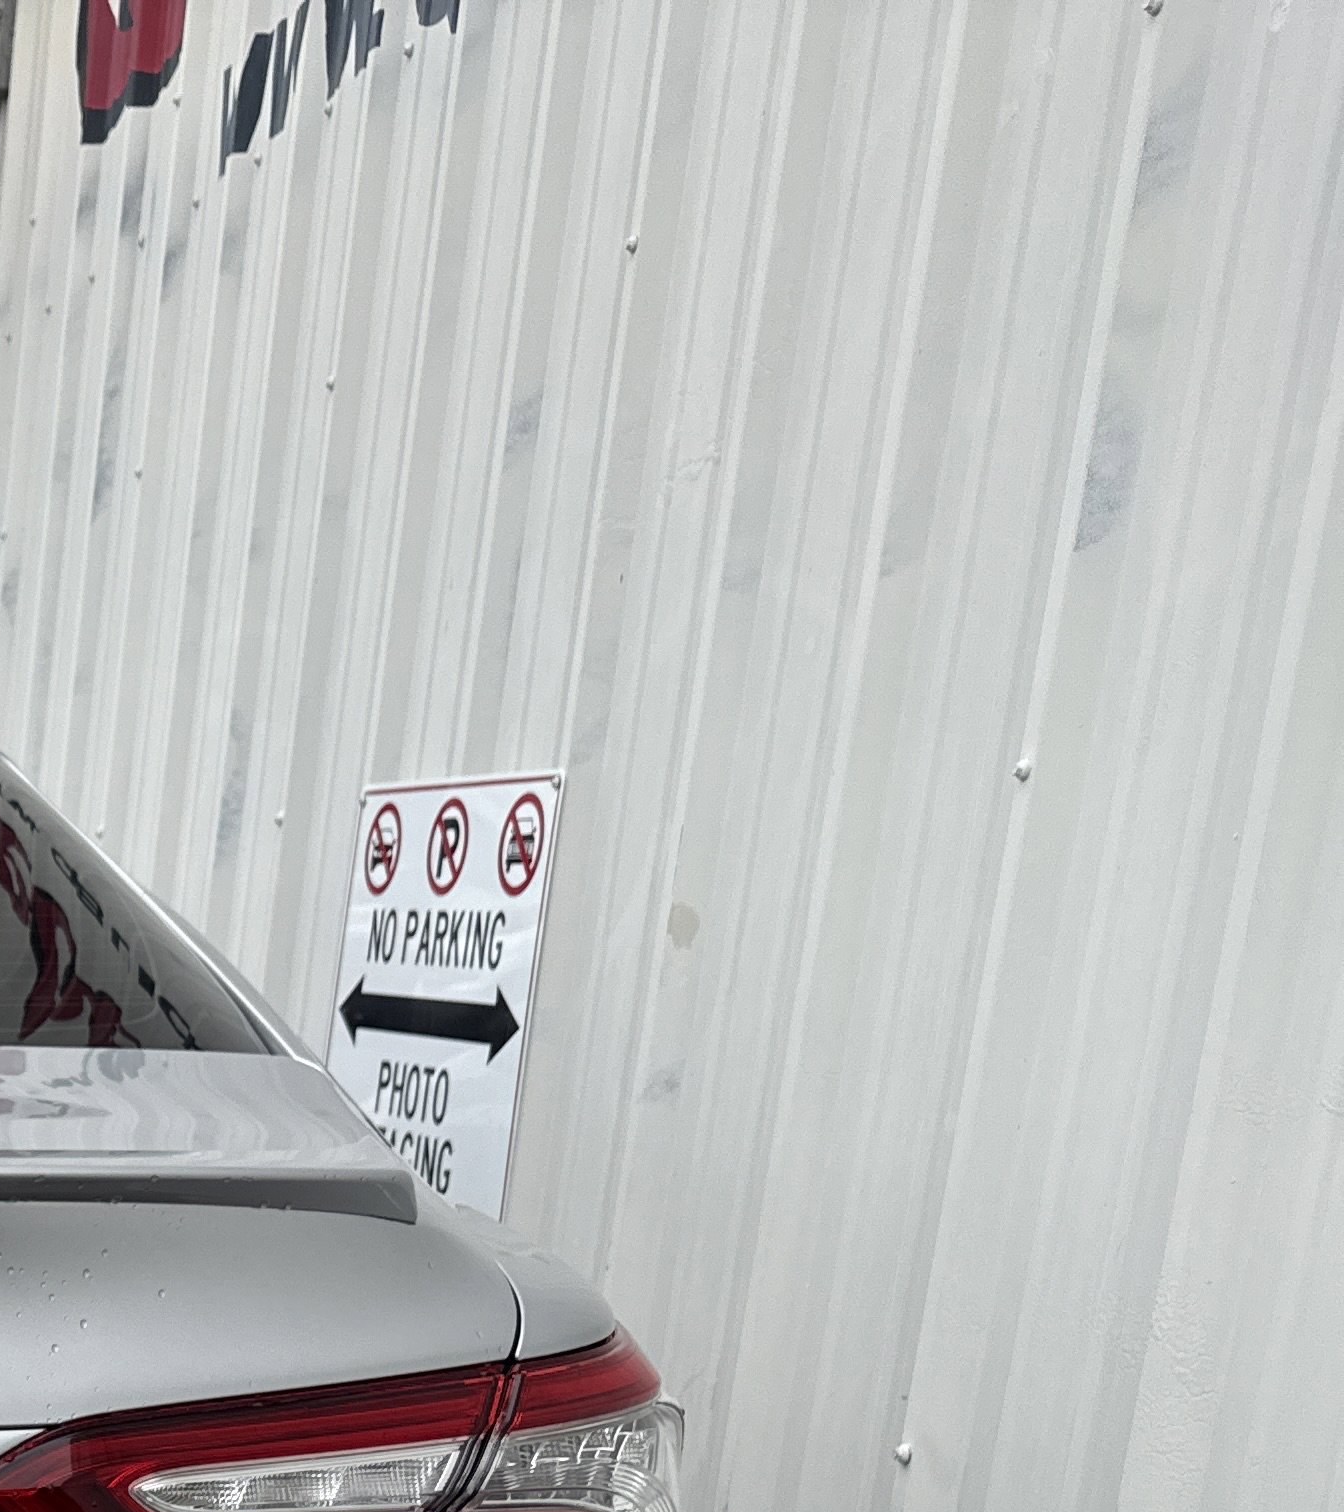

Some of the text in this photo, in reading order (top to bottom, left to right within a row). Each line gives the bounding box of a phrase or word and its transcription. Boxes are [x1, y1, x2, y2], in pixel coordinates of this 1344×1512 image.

[367, 908, 506, 970] NO PARKING
[374, 1060, 449, 1126] PHOTO
